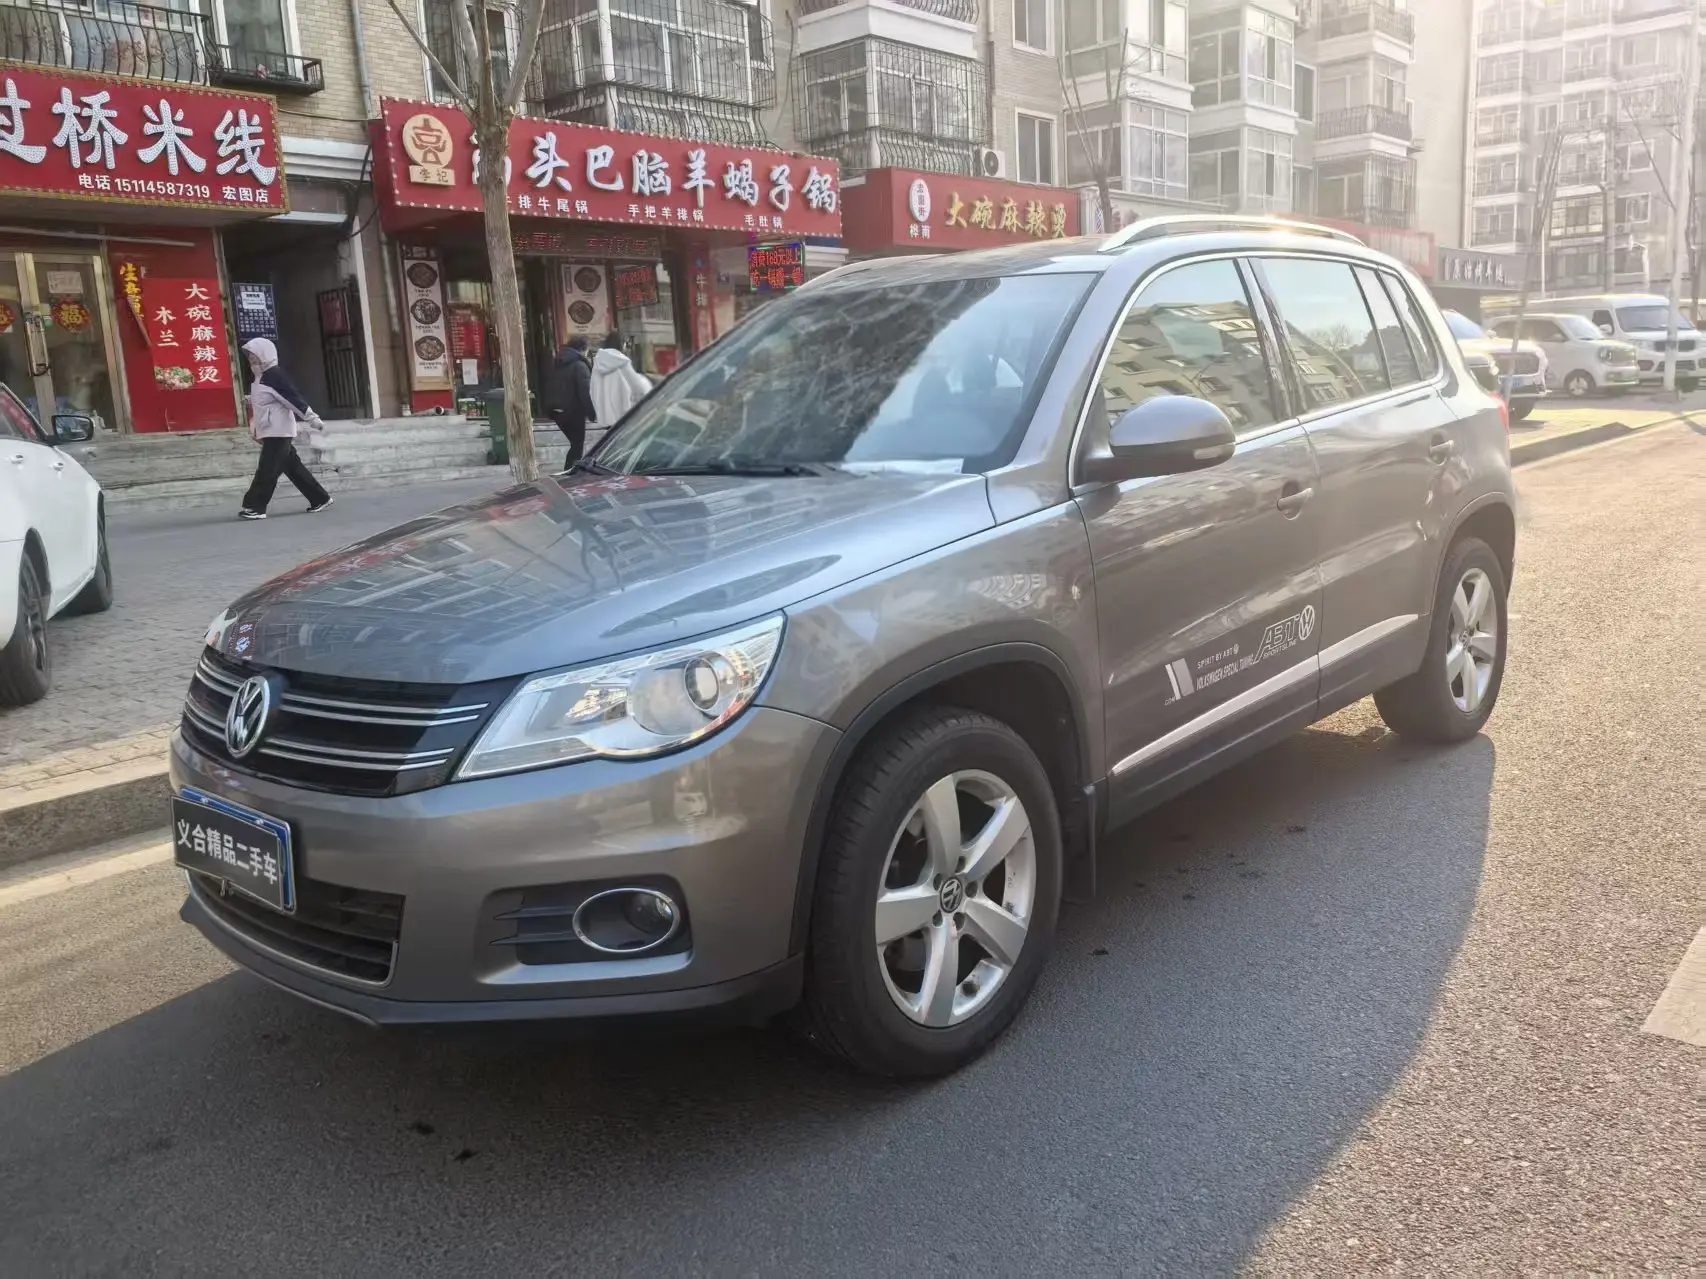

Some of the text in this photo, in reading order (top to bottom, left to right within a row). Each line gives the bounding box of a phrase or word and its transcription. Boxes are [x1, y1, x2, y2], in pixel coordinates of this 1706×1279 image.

[0, 78, 277, 186] 过桥米线
[78, 174, 269, 204] 电话 15114587319 宏图店
[627, 204, 705, 222] 手把羊排锅
[744, 214, 783, 229] 毛肚锅
[153, 305, 180, 348] 木兰
[184, 283, 222, 383] 大碗麻辣烫
[1197, 655, 1215, 669] SPIRIT
[1215, 651, 1223, 662] BY
[1252, 613, 1301, 665] ABT
[177, 818, 278, 885] 义合精品二手车
